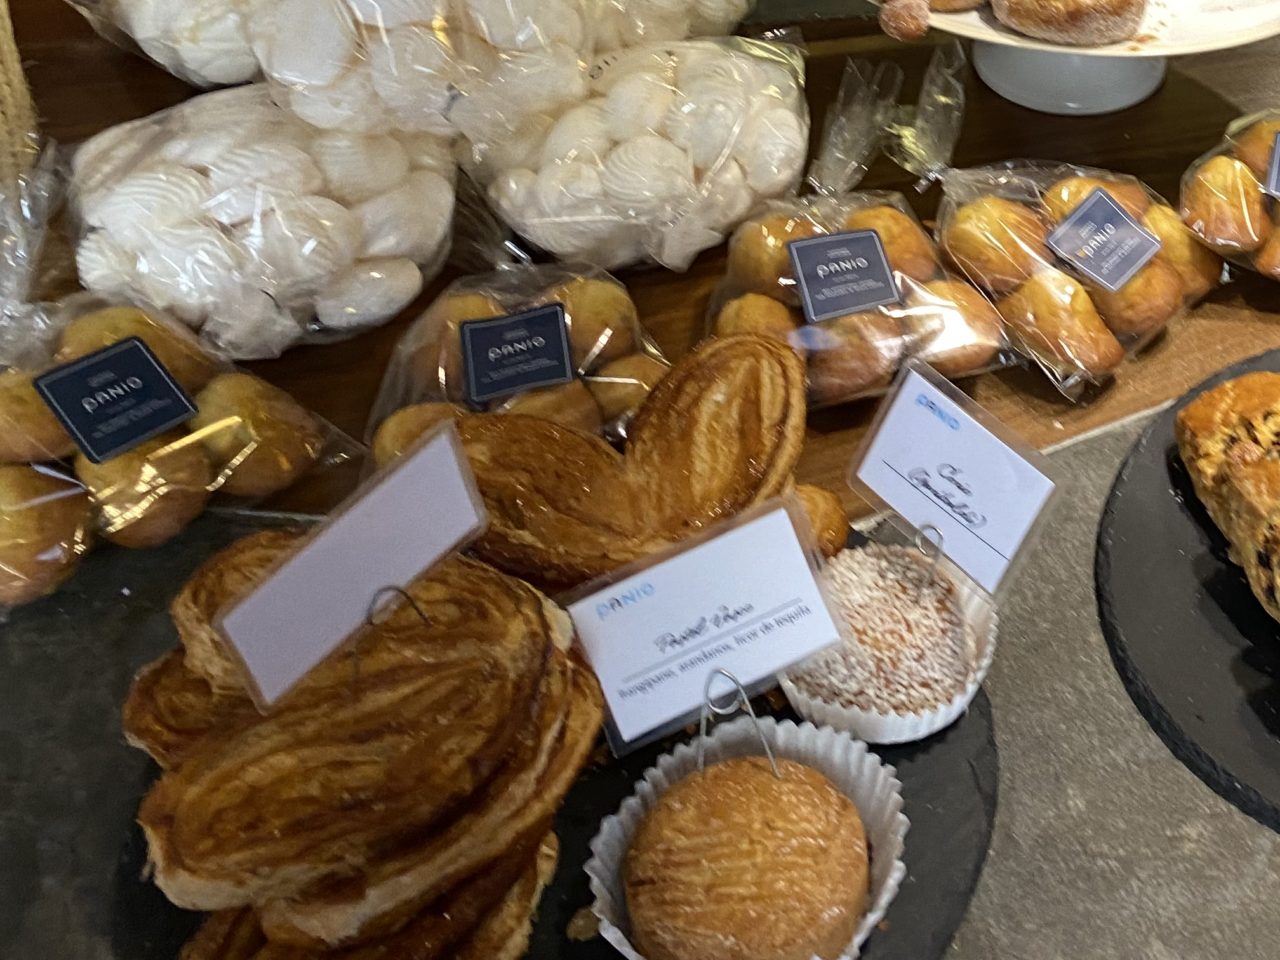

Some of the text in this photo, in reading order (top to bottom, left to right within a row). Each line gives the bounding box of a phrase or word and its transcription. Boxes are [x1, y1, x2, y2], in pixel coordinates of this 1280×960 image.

[1080, 223, 1117, 259] PANIO
[816, 257, 869, 280] PANIO
[488, 336, 546, 362] PANIO
[81, 376, 143, 414] PANIO
[595, 581, 656, 623] PANIO
